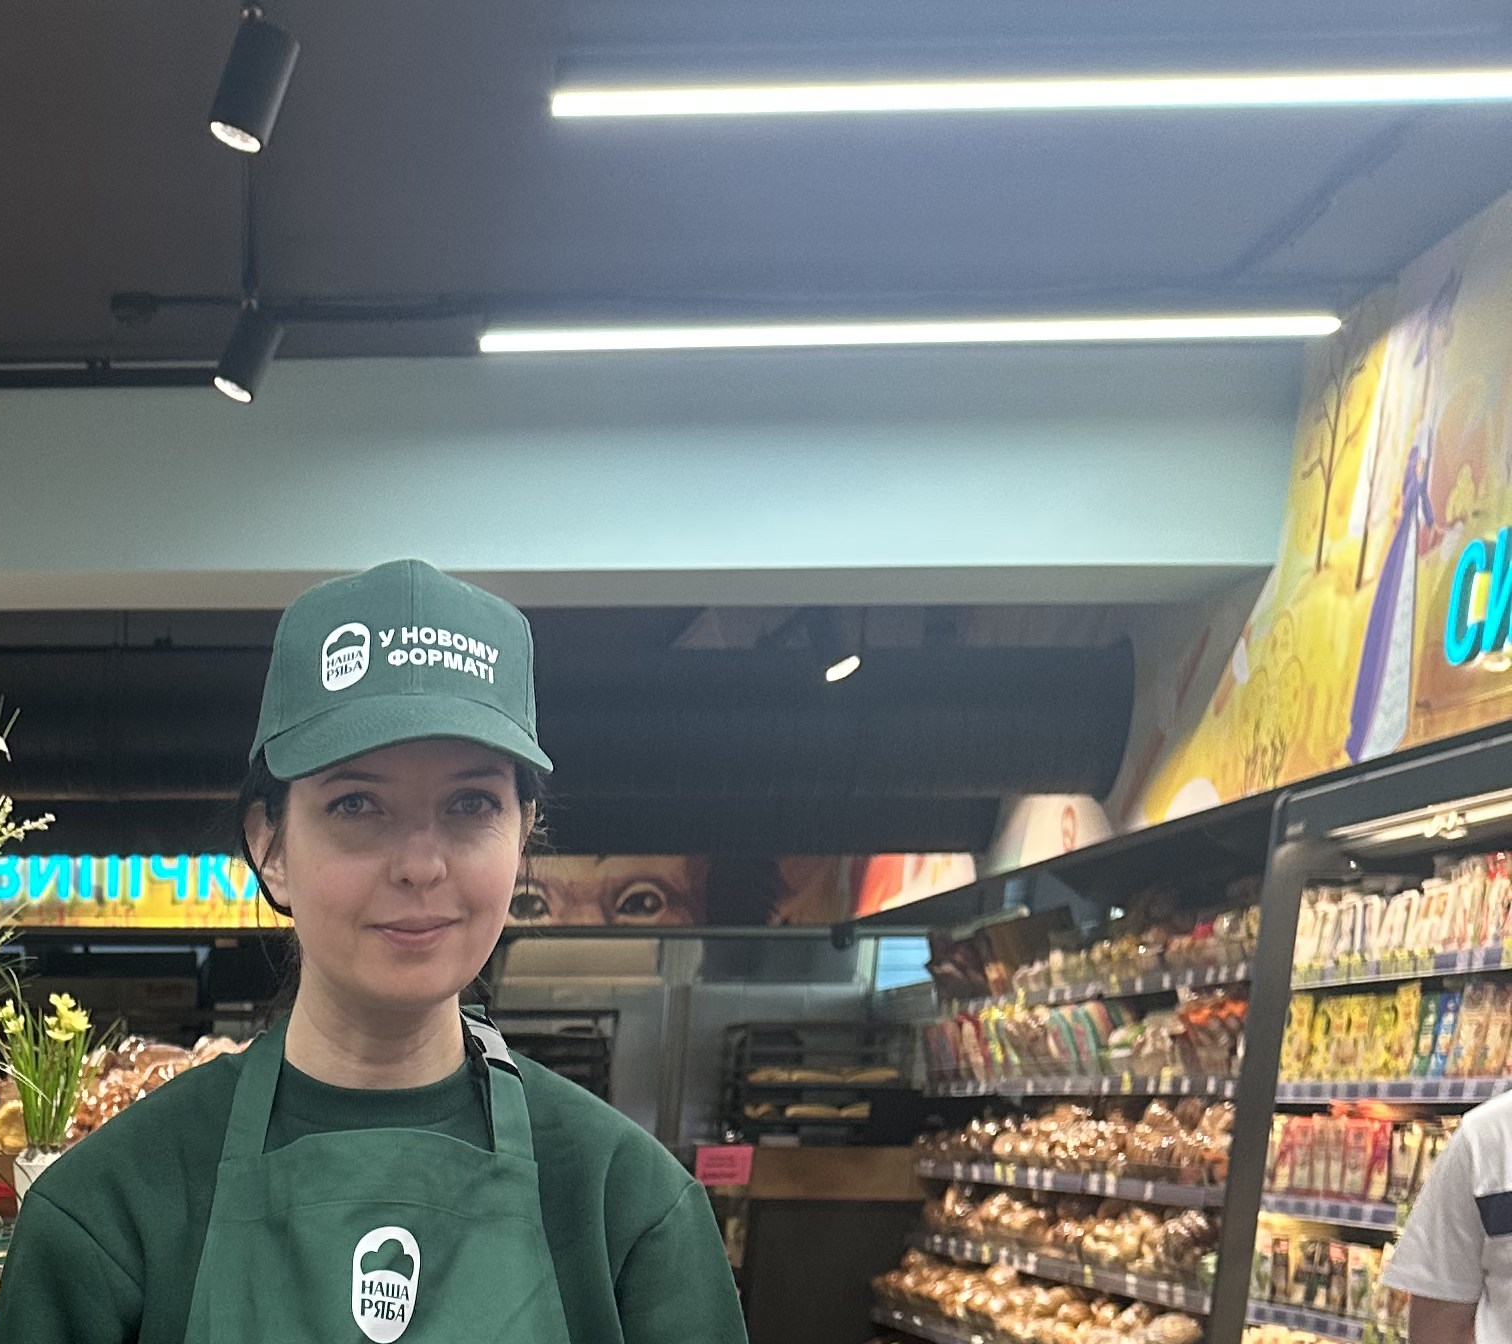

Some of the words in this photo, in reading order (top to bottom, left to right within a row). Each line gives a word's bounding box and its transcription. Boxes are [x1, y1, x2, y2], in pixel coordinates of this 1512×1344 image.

[379, 629, 395, 647] У
[402, 627, 499, 664] НОВОМУ
[326, 650, 364, 668] НАША
[388, 647, 494, 684] ФОРМАТІ
[326, 662, 364, 681] РЯБА
[361, 1280, 409, 1300] НАША
[360, 1298, 406, 1323] РЯБА
